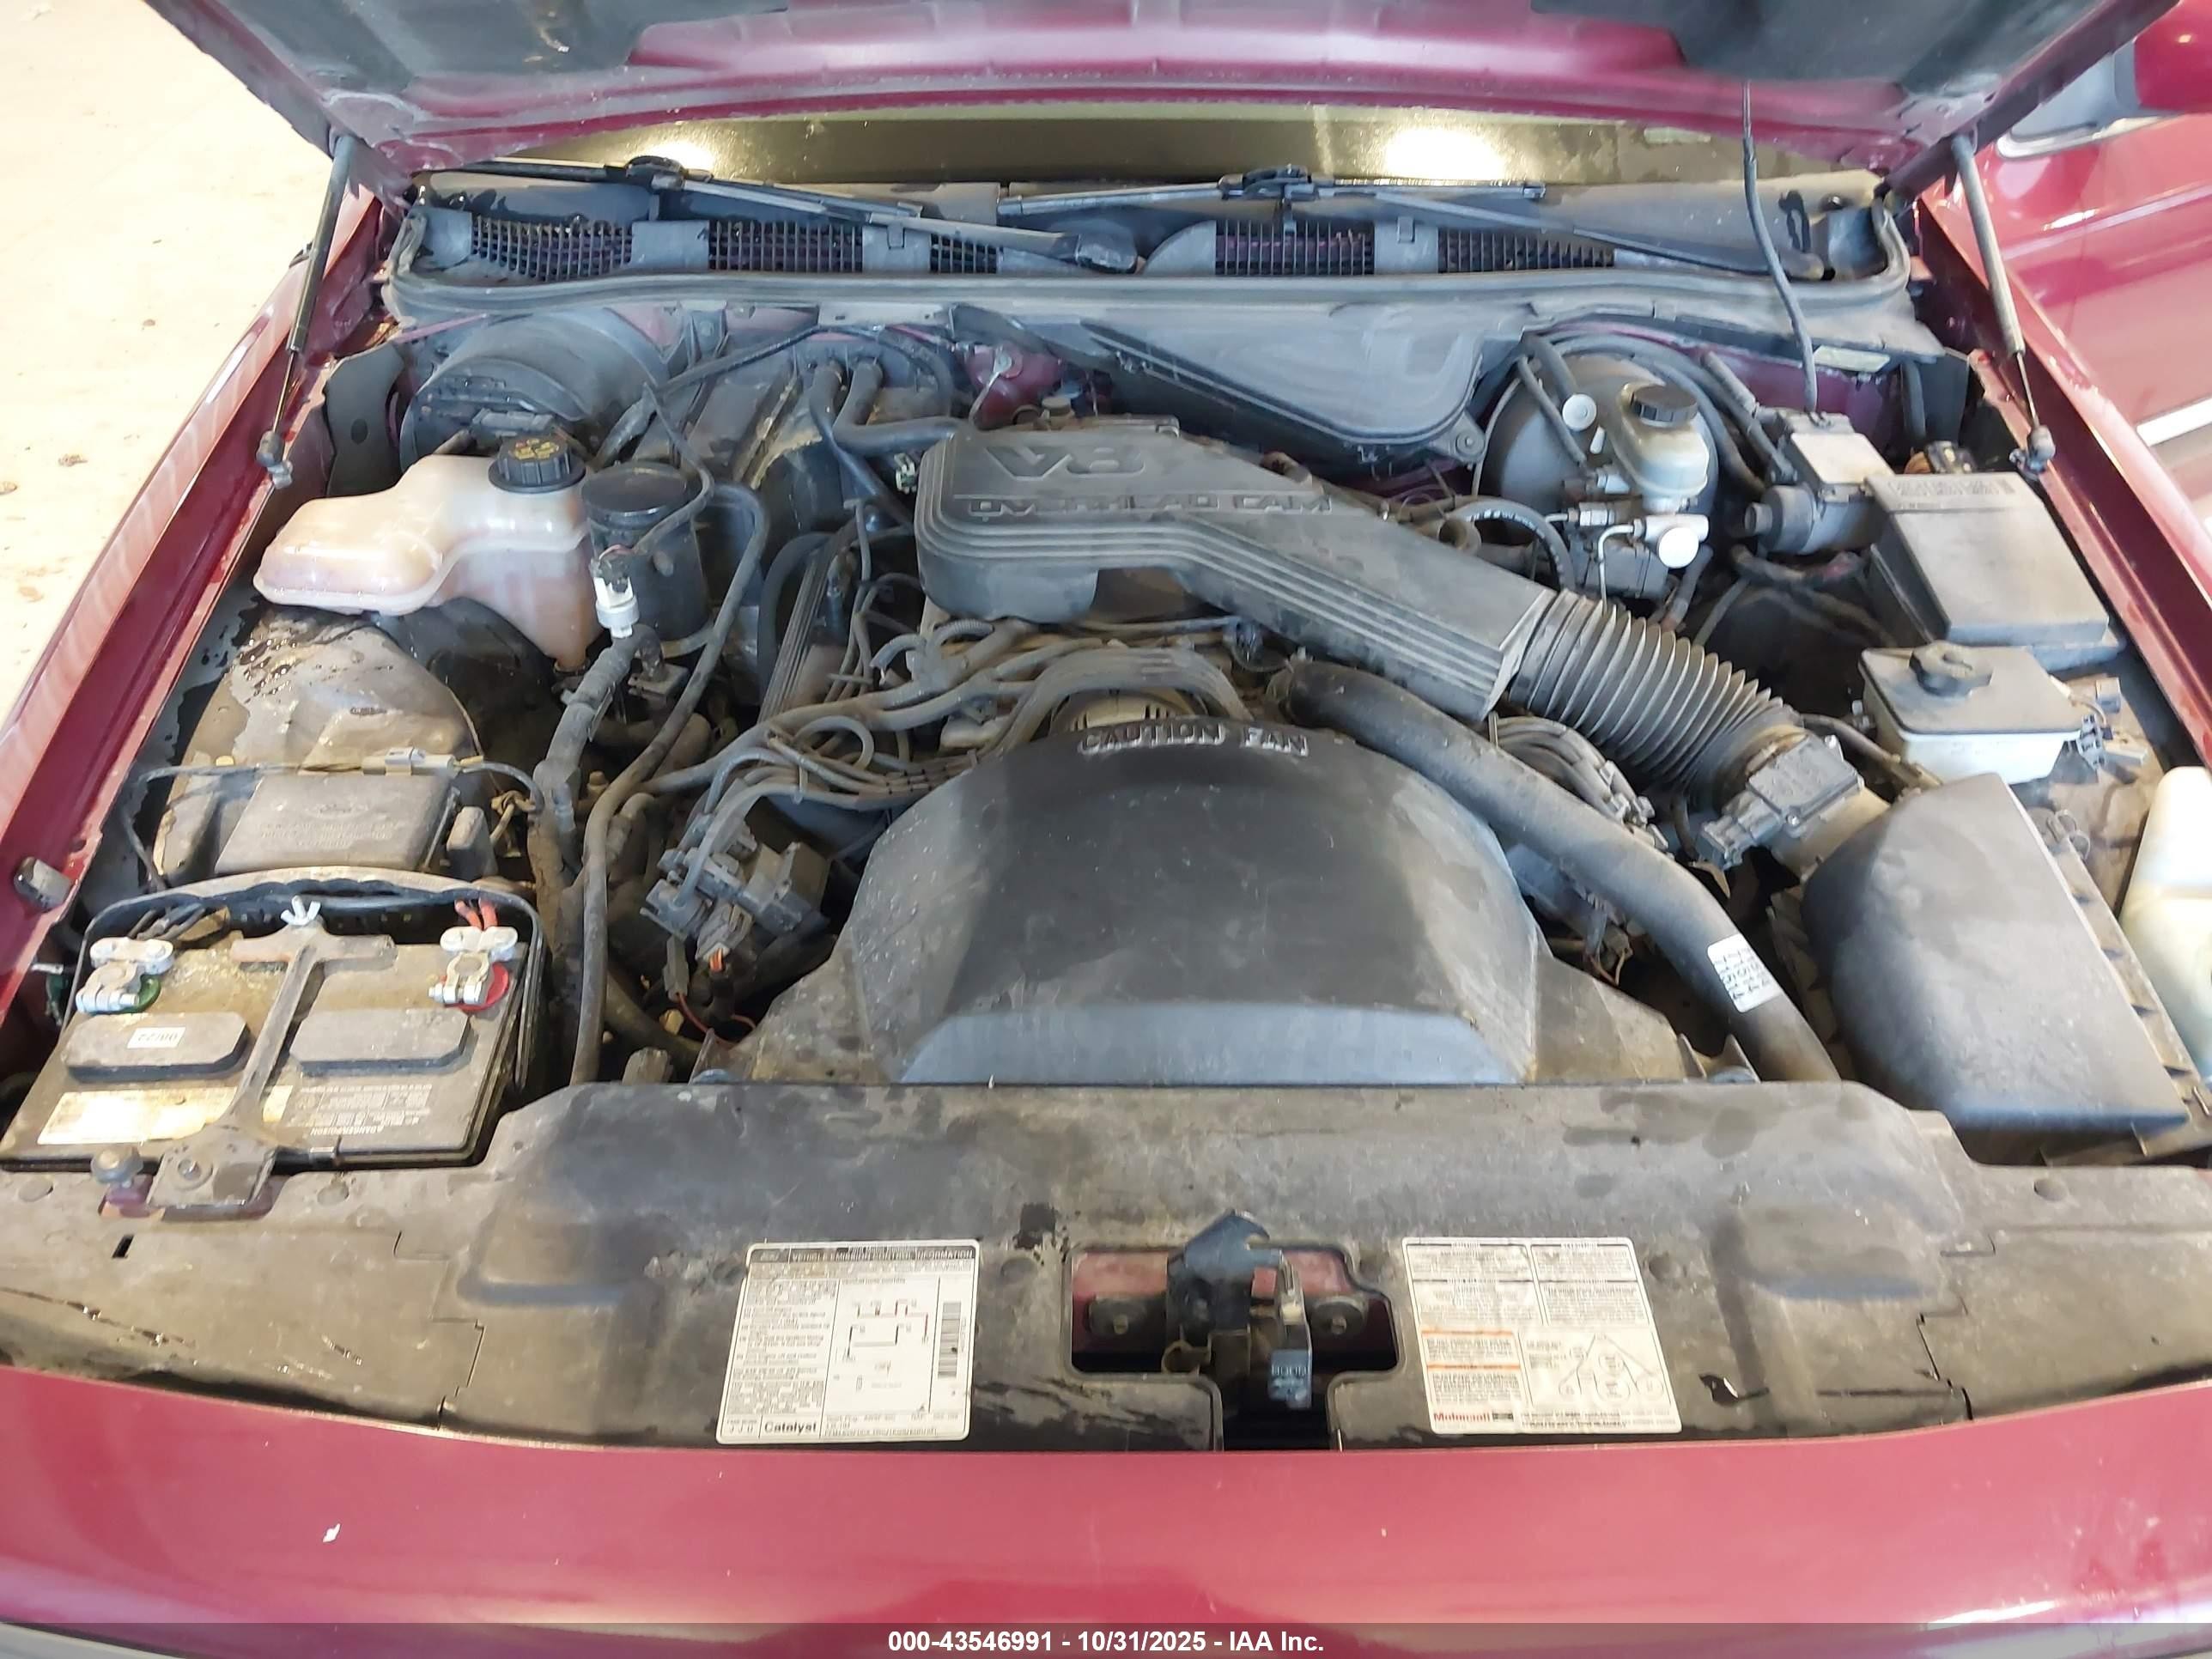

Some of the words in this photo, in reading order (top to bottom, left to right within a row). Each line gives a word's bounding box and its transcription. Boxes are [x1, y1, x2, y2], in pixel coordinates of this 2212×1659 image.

[968, 494, 1220, 515] OVERHEAD
[1231, 494, 1333, 514] CAM
[1076, 721, 1226, 754] CAUTION
[1239, 726, 1310, 757] FAN
[763, 1419, 817, 1435] Catalyst
